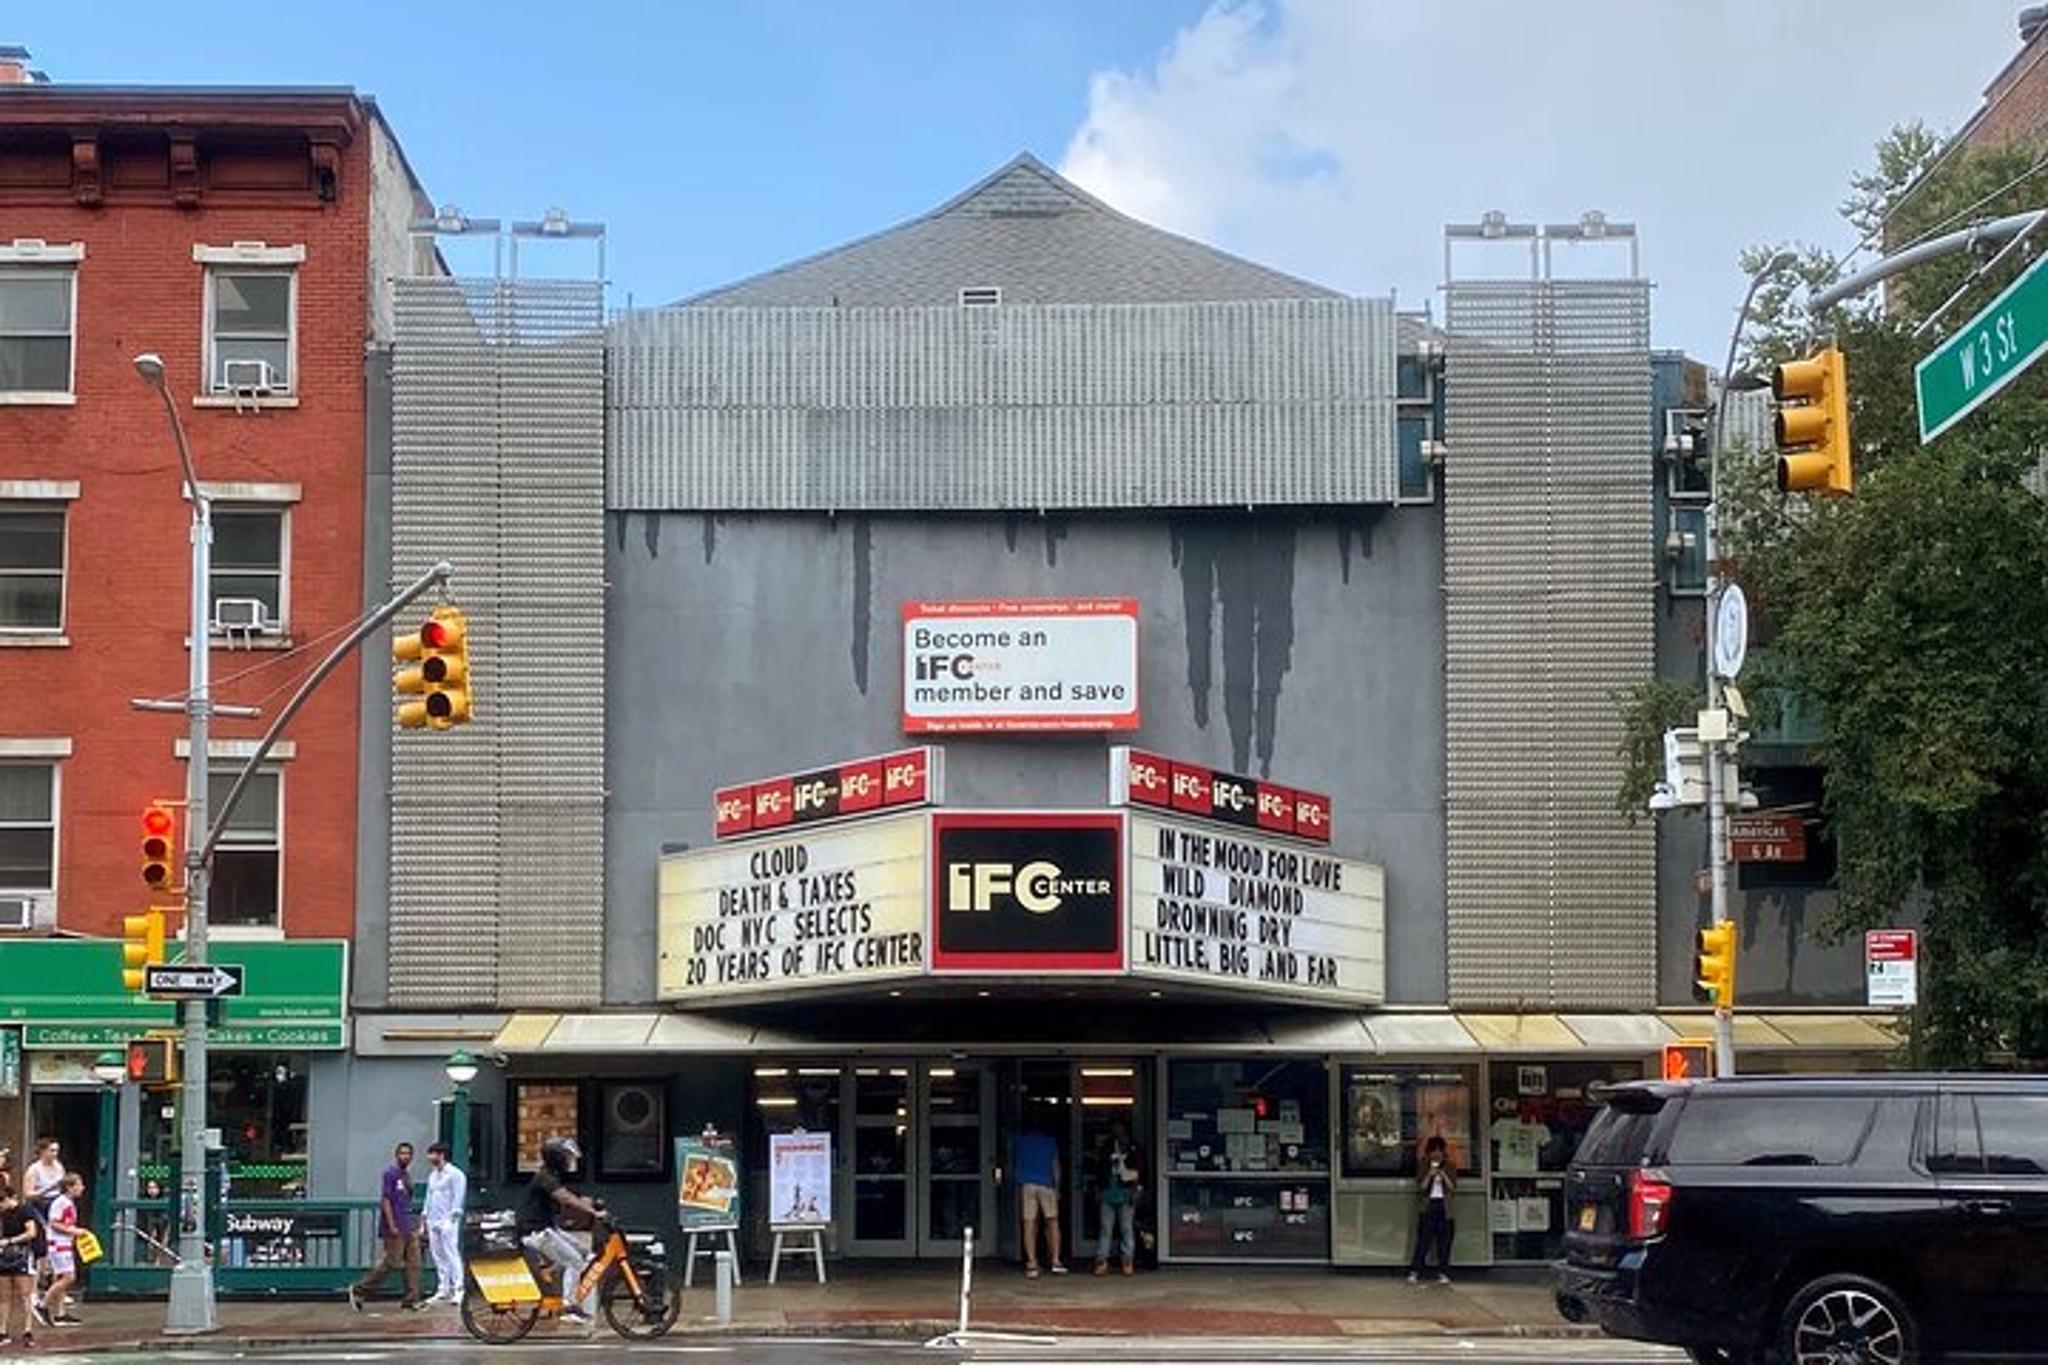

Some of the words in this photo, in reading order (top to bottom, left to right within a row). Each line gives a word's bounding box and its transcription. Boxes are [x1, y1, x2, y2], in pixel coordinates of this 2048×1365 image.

[1959, 344, 1975, 391] W
[1980, 331, 1993, 376] 3
[1996, 312, 2018, 362] St
[915, 628, 1011, 649] Become
[1018, 630, 1047, 647] an
[915, 683, 1012, 702] member
[1020, 683, 1063, 701] and
[1071, 684, 1126, 700] save
[750, 845, 808, 880] CLOUD
[1159, 828, 1176, 859] IN
[1180, 833, 1210, 867] THE
[1214, 839, 1263, 876] MOOD
[1268, 849, 1297, 883] FOR
[1302, 856, 1341, 891] LOVE
[718, 879, 772, 918] DEATH
[777, 881, 789, 908] &
[800, 870, 857, 908] TAXES
[1034, 880, 1112, 895] CENTER
[1162, 863, 1205, 899] WILD
[1228, 876, 1303, 916] DIAMOND
[693, 924, 726, 953] DOC
[741, 916, 776, 948] NYC
[794, 903, 871, 942] SELECTS
[1157, 898, 1247, 941] DROWNING
[1259, 914, 1293, 947] DRY
[687, 957, 706, 985] 20
[717, 951, 770, 982] YEARS
[781, 946, 803, 976] OF
[816, 941, 846, 971] IFC
[853, 932, 923, 968] CENTER
[1307, 954, 1339, 988] FAR
[155, 974, 180, 988] ONE
[195, 975, 223, 987] WAY
[38, 1028, 89, 1042] Coffee
[206, 1028, 252, 1042] Cakes
[266, 1027, 329, 1042] Cookies
[226, 1212, 295, 1236] Subway
